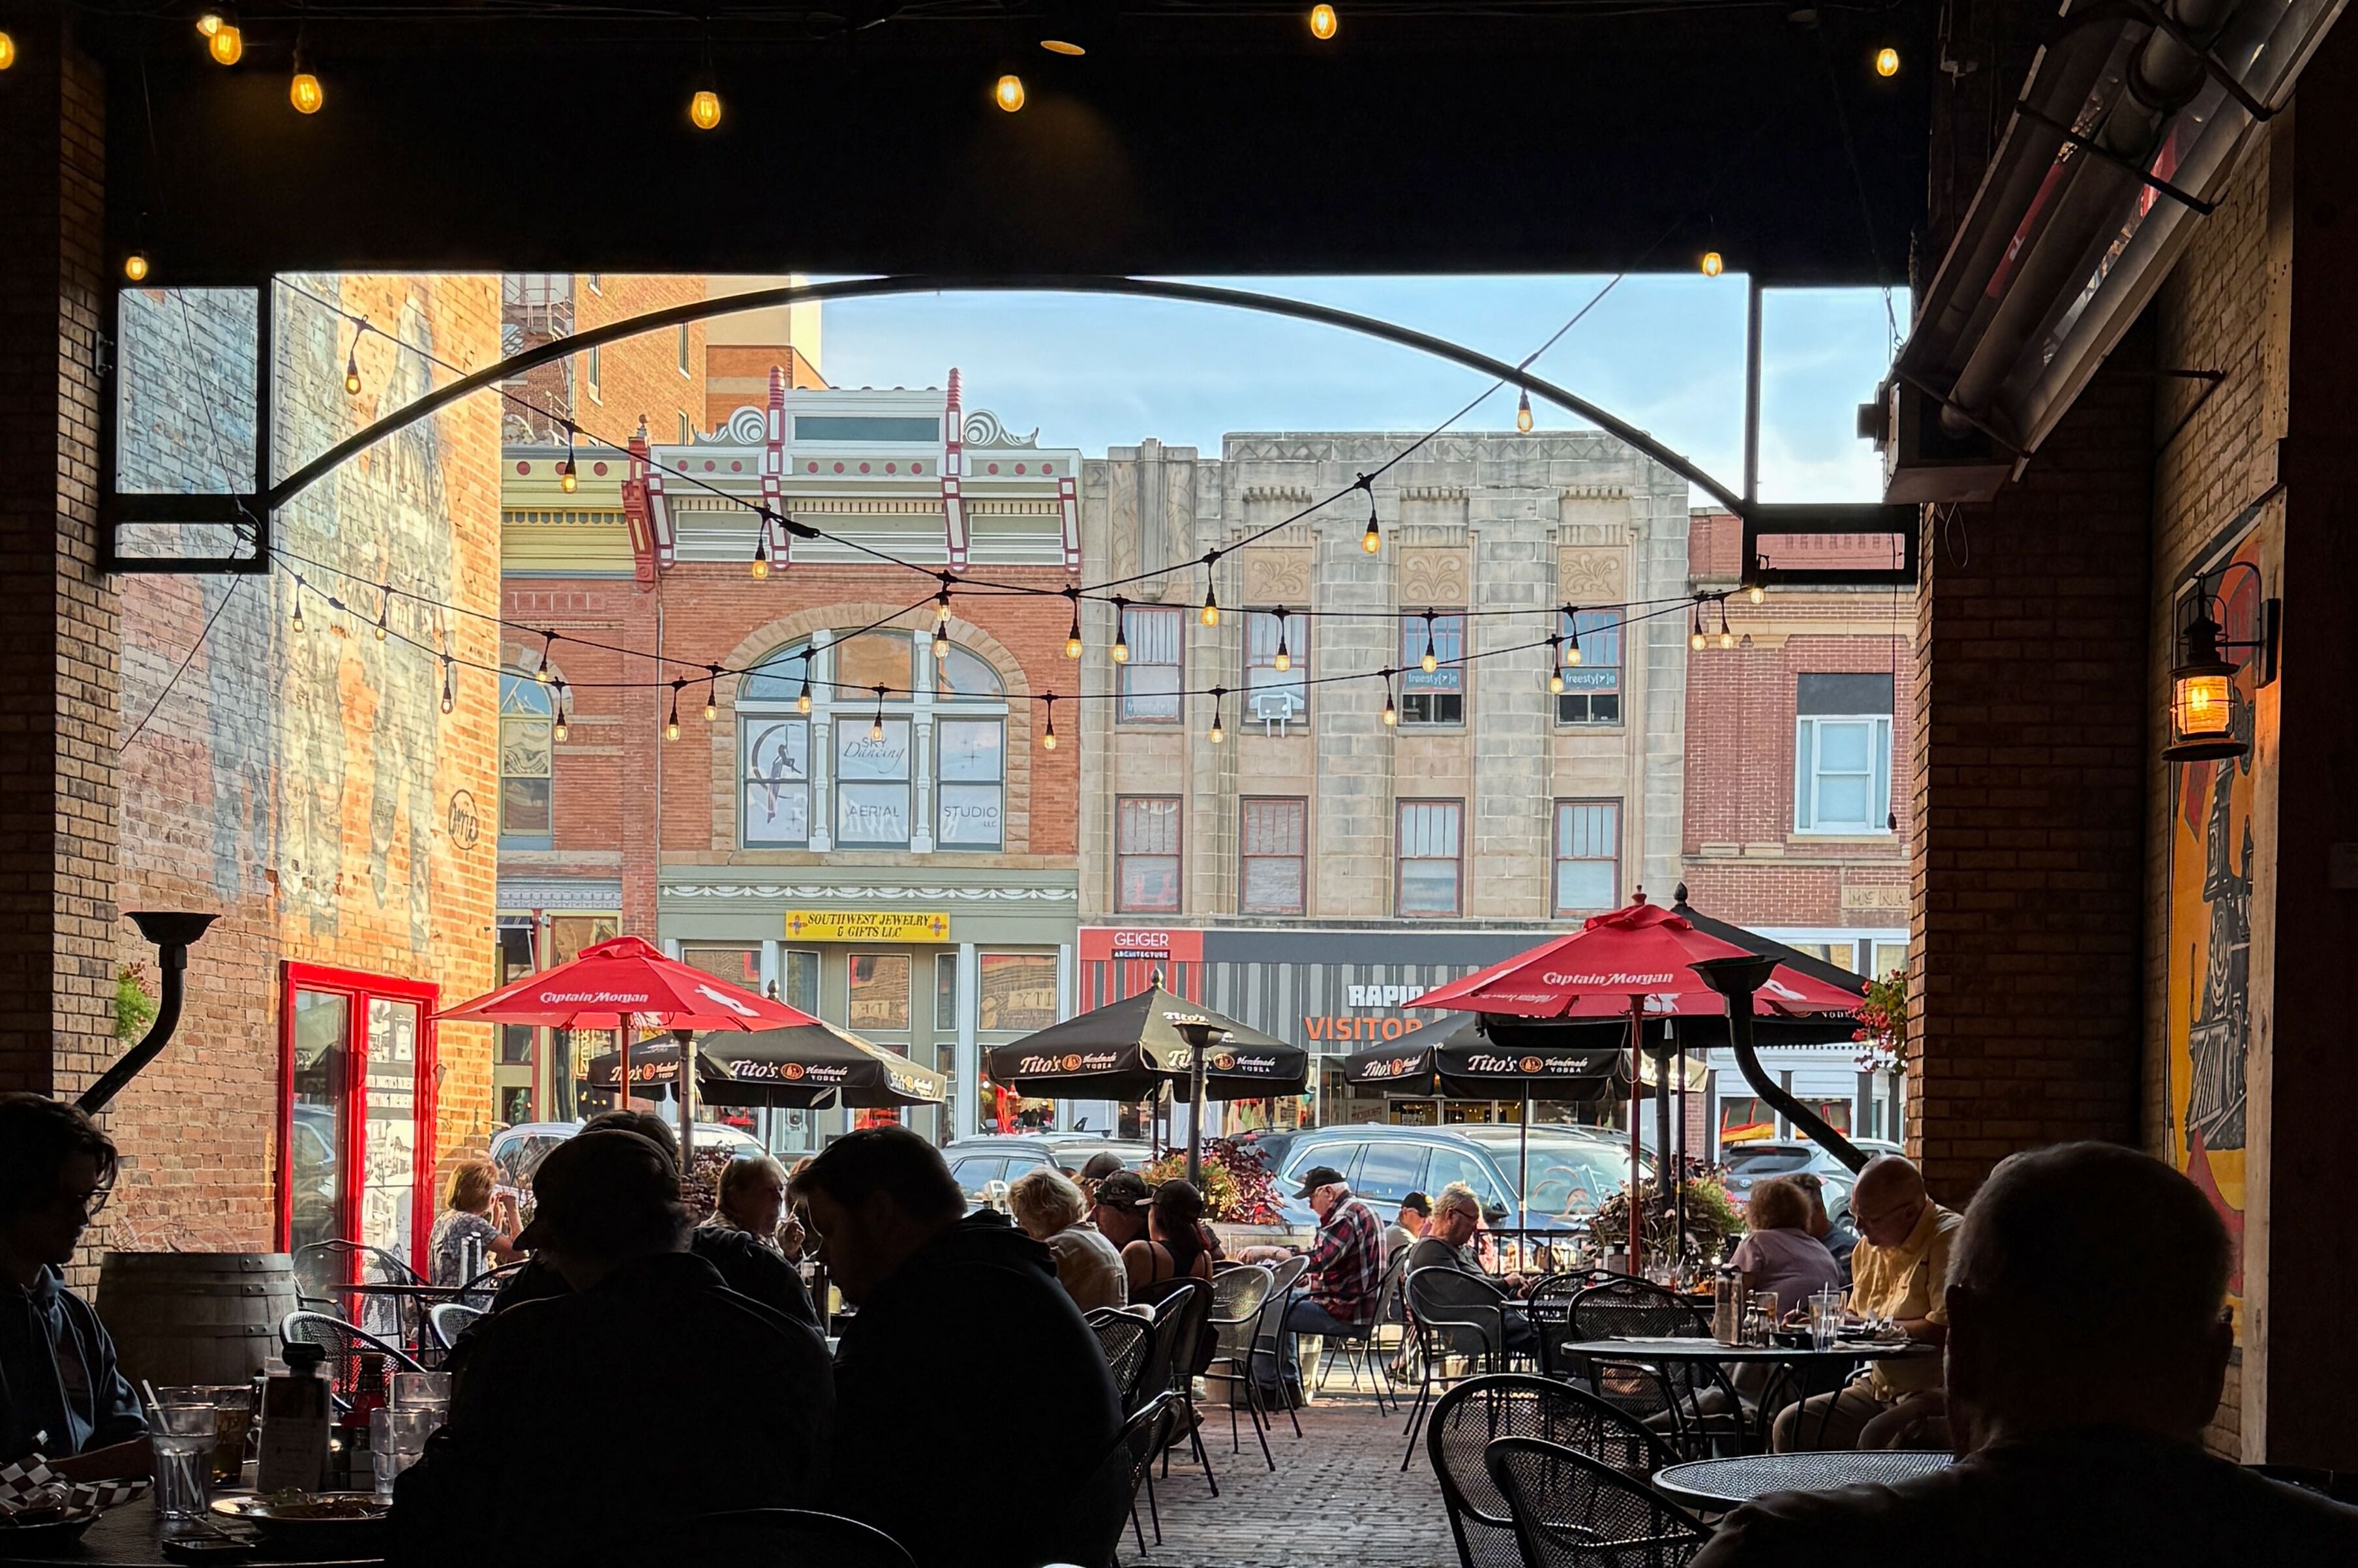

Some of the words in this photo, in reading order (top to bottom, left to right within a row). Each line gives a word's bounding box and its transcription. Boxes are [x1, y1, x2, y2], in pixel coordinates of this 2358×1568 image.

[862, 737, 887, 747] SKY
[843, 742, 906, 774] Dancing
[848, 806, 899, 817] AERIAL
[944, 806, 998, 818] STUDIO
[808, 914, 876, 925] SOUTHWEST
[879, 914, 931, 926] JEWELRY
[848, 926, 879, 937] GIFTS
[882, 927, 901, 937] LLC
[1114, 932, 1169, 946] GEIGER
[1543, 972, 1603, 986] Captain
[1600, 972, 1673, 986] Morgan
[540, 992, 592, 1003] Captain
[730, 1059, 778, 1078] Tito's
[1020, 1055, 1061, 1073] Tito's
[1468, 1054, 1517, 1072] Tito's
